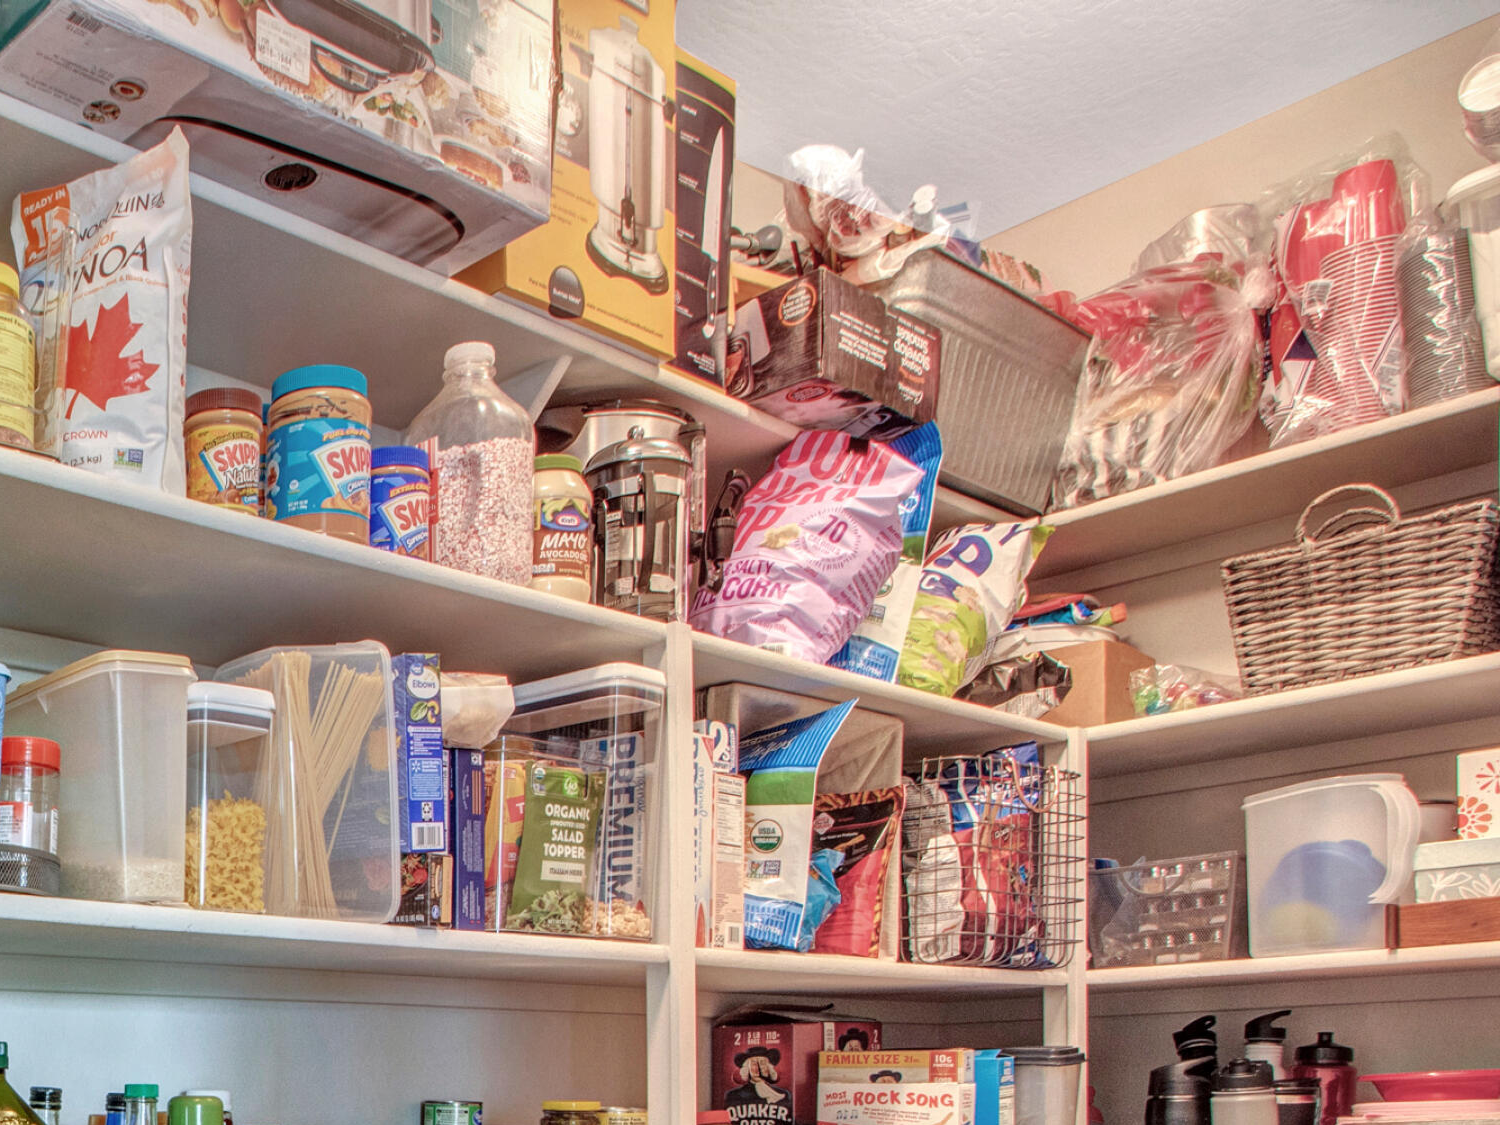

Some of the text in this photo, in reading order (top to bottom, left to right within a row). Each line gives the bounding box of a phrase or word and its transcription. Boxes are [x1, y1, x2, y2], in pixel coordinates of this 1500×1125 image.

[24, 189, 67, 217] READY IN
[31, 207, 68, 250] 15
[213, 441, 260, 472] SKIPP
[326, 445, 370, 480] SKIPP
[817, 514, 849, 544] 70
[541, 532, 588, 551] MAYO
[540, 550, 581, 560] AVOCADO
[733, 559, 774, 578] SALTY
[722, 576, 791, 600] CORN
[411, 678, 436, 690] Elbows
[545, 803, 591, 821] ORGANIC
[608, 735, 637, 902] PREMIUM
[551, 828, 584, 844] SALAD
[543, 843, 587, 860] TOPPER
[734, 1032, 741, 1046] 2
[826, 1053, 871, 1065] FAMILY
[873, 1053, 900, 1065] SIZE
[825, 1090, 955, 1108] MOST ROCK SONG
